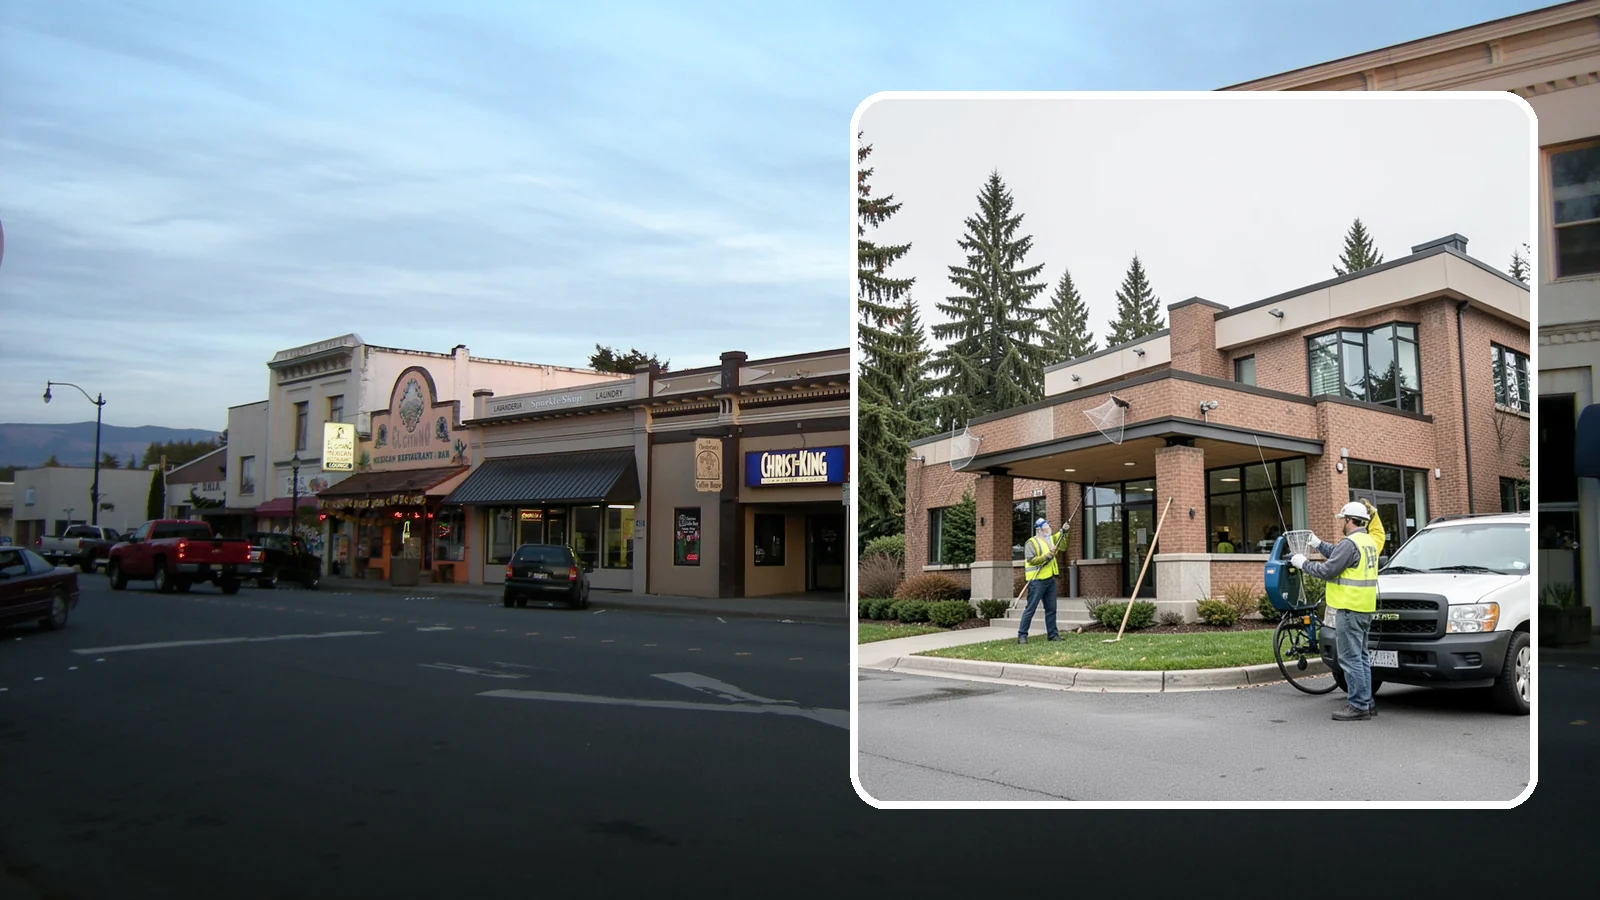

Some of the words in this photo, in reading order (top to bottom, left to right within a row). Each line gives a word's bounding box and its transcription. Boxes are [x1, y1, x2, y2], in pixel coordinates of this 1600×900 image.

[494, 402, 522, 412] LAVANDERIA
[531, 398, 560, 409] Sparkle
[562, 394, 582, 405] Shop
[596, 389, 624, 400] LAUNDRY
[373, 454, 396, 464] MEXICAN
[398, 451, 433, 462] RESTAURANT
[438, 450, 450, 459] BAR
